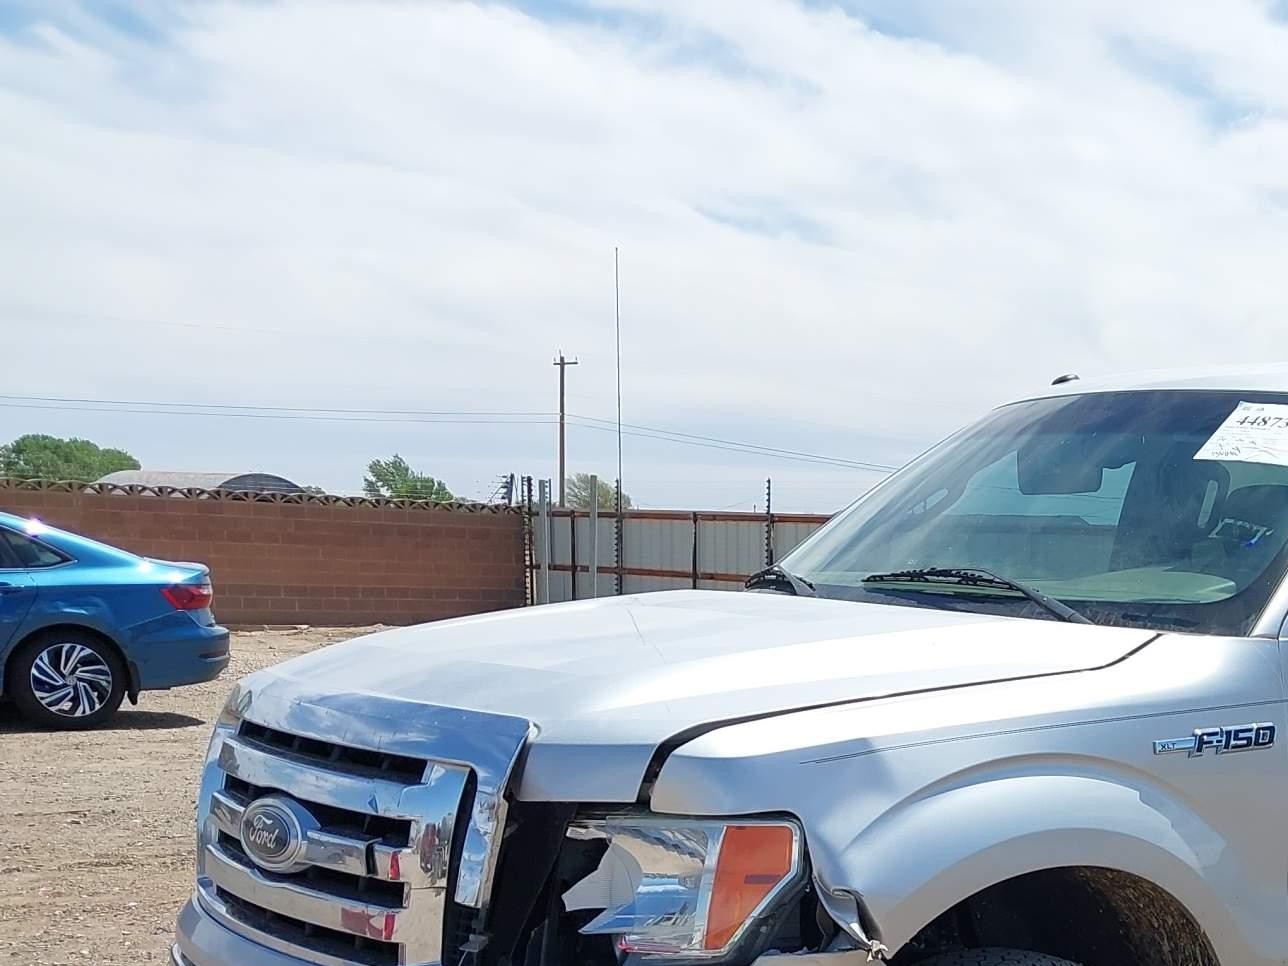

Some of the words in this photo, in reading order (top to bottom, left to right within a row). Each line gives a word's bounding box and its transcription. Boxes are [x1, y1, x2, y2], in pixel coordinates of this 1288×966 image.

[1160, 742, 1177, 751] XLT
[1193, 723, 1276, 753] F-150
[250, 814, 279, 849] Ford
